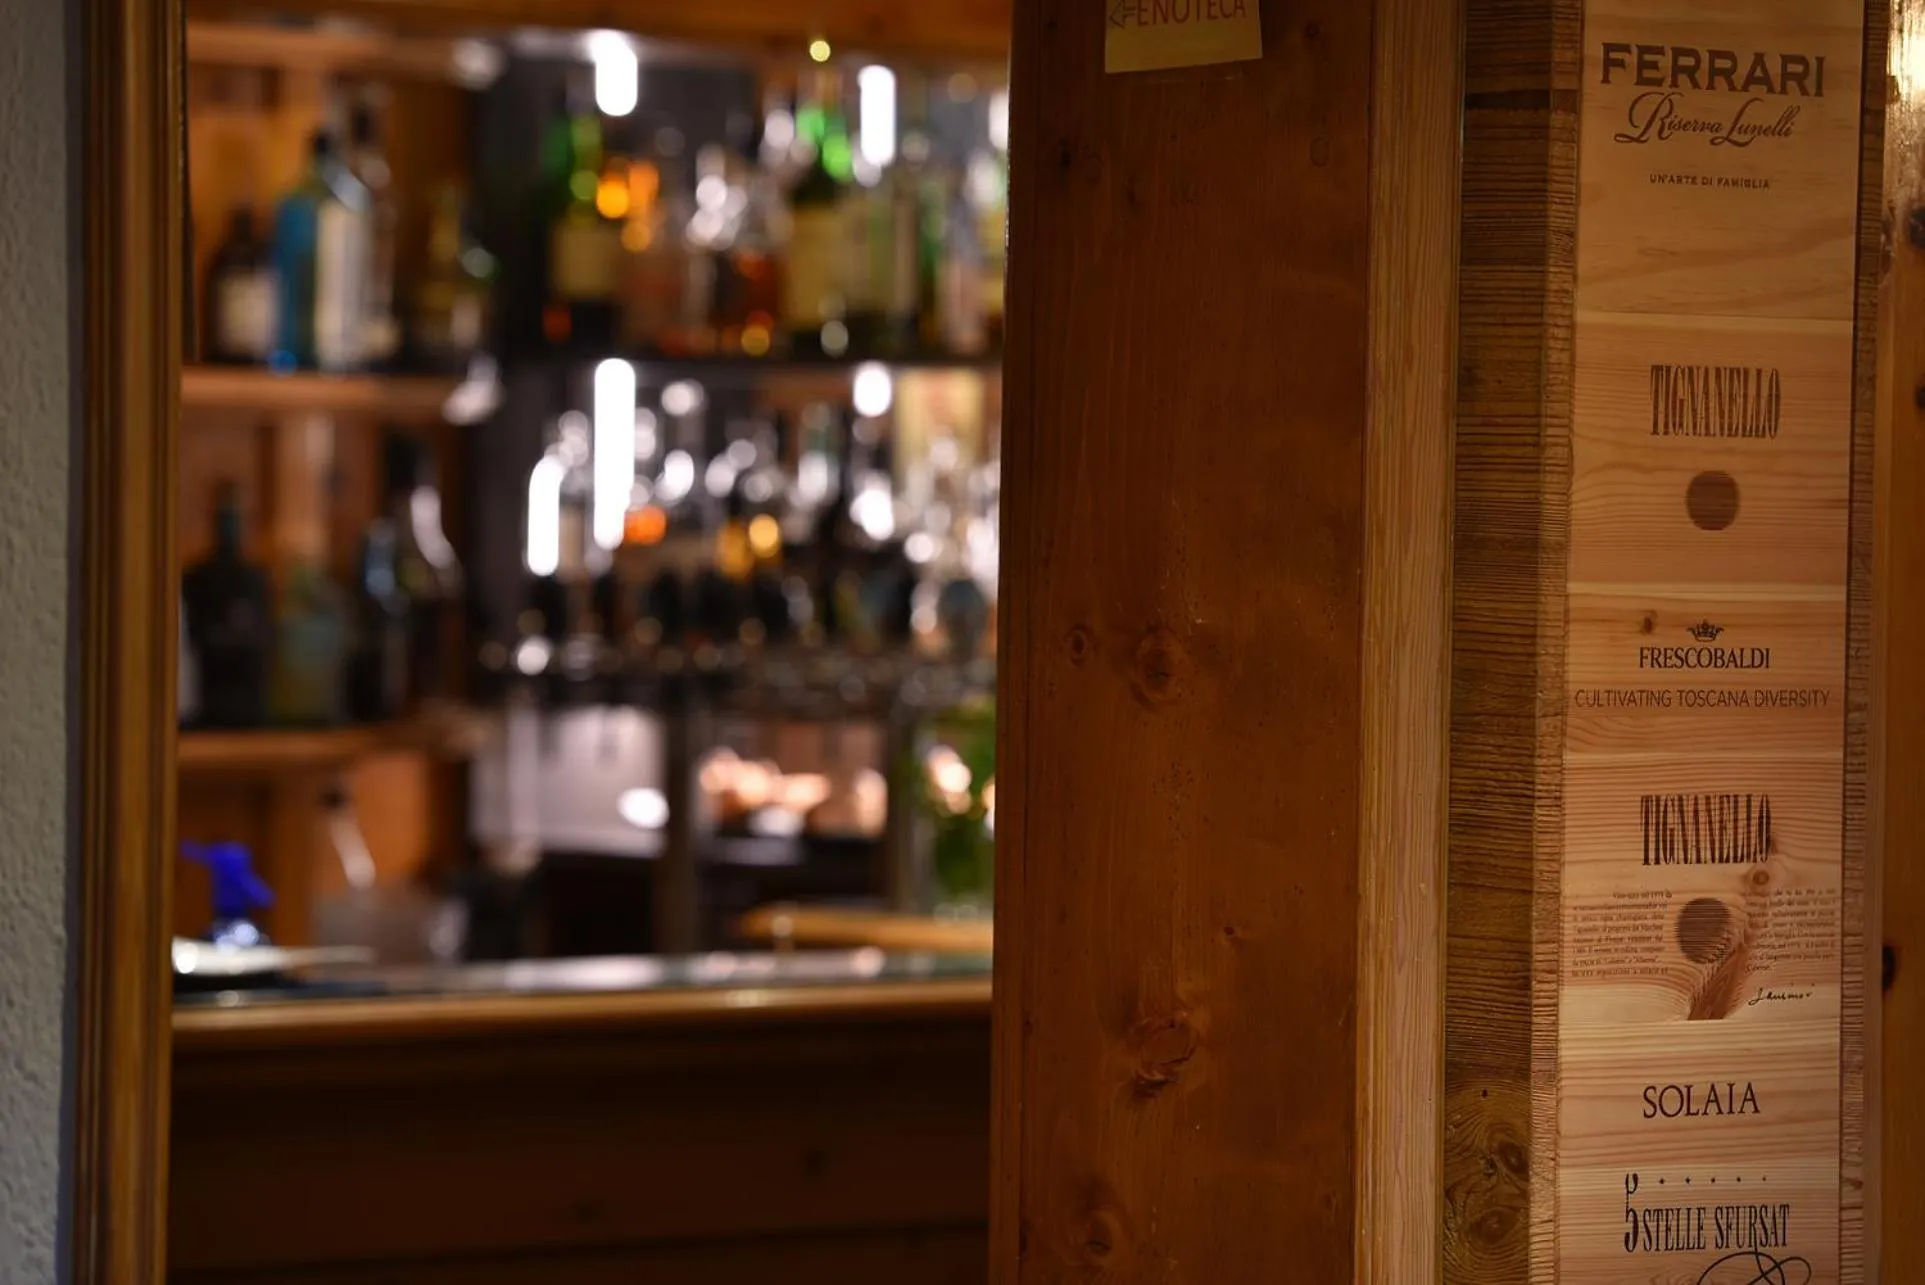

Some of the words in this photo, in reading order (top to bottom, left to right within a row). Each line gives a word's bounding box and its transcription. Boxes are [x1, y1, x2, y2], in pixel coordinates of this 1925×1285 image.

[1600, 42, 1826, 98] FERRARI
[1613, 91, 1724, 144] Riserva
[1709, 97, 1801, 148] Lunelli
[1650, 173, 1698, 186] UN'ARTE
[1701, 175, 1714, 187] DI
[1717, 176, 1770, 189] FAMIGLIA
[1650, 364, 1781, 440] TIGNANELLO
[1639, 646, 1771, 669] FRESCOBALDI
[1575, 688, 1672, 708] CULTIVATING
[1677, 689, 1750, 708] TOSCANA
[1754, 689, 1830, 708] DIVERSITY
[1639, 794, 1772, 866] TIGNANELLO
[1643, 1081, 1761, 1119] SOLAIA
[1623, 1172, 1639, 1253] 5
[1643, 1206, 1707, 1252] STELLE
[1714, 1203, 1790, 1250] SFURSAT
